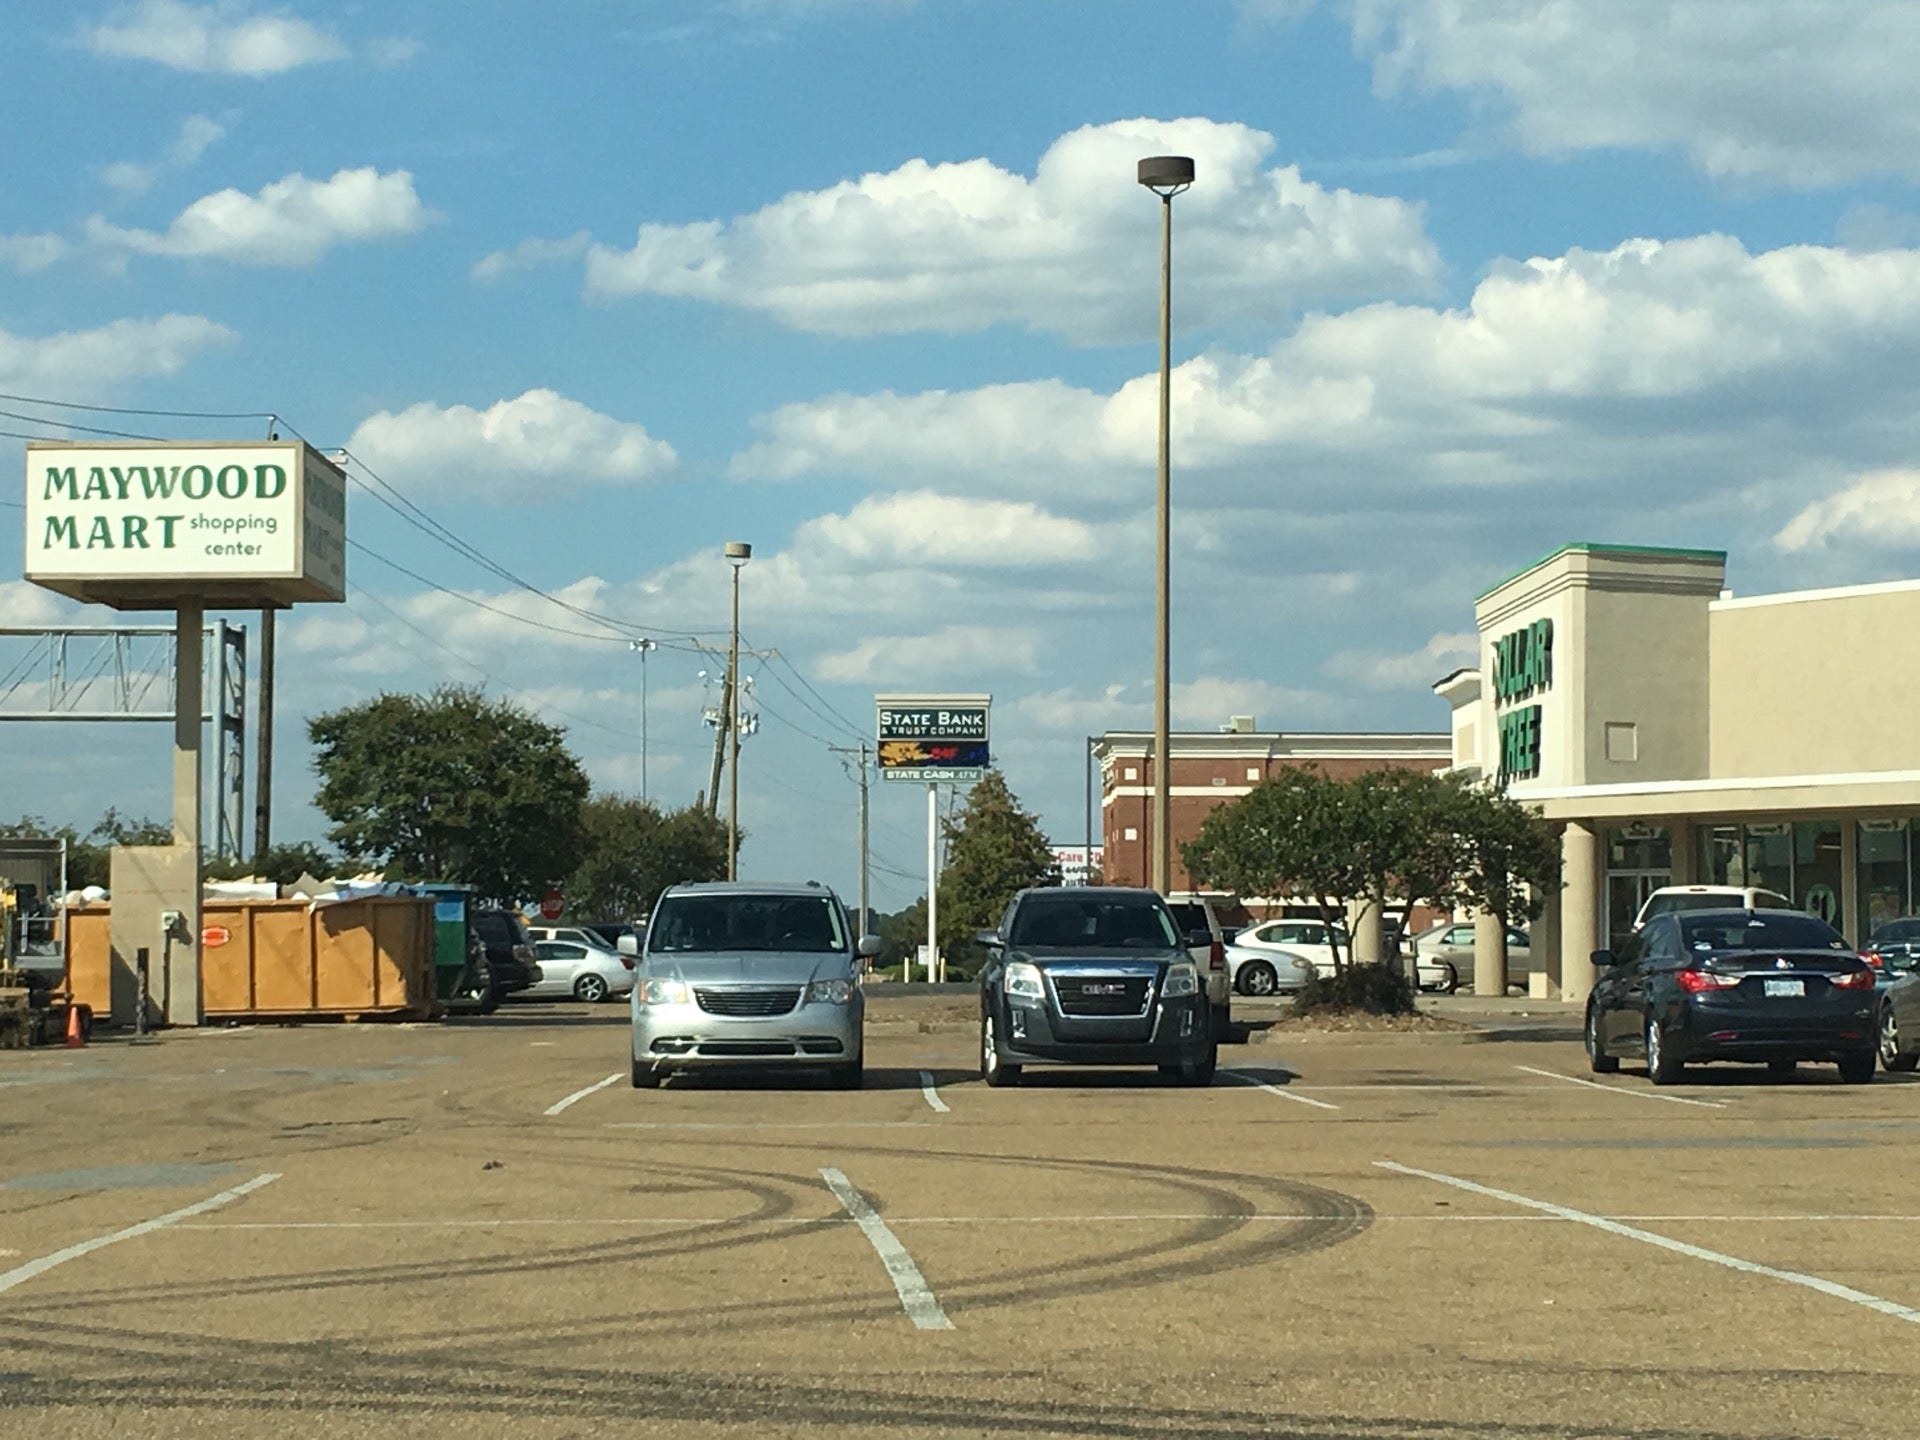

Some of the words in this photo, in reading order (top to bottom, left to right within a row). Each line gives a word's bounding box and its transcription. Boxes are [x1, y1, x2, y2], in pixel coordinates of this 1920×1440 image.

[44, 464, 287, 500] MAYWOOD
[190, 513, 278, 534] shopping
[43, 515, 185, 549] MART
[204, 541, 262, 556] center
[881, 711, 931, 725] STATE
[938, 711, 983, 725] BANK
[892, 727, 926, 735] TRUST
[930, 727, 983, 735] COMPANY
[1498, 705, 1542, 779] TREE
[887, 771, 920, 779] STATE
[923, 771, 954, 779] CASH
[1081, 984, 1126, 995] GMC
